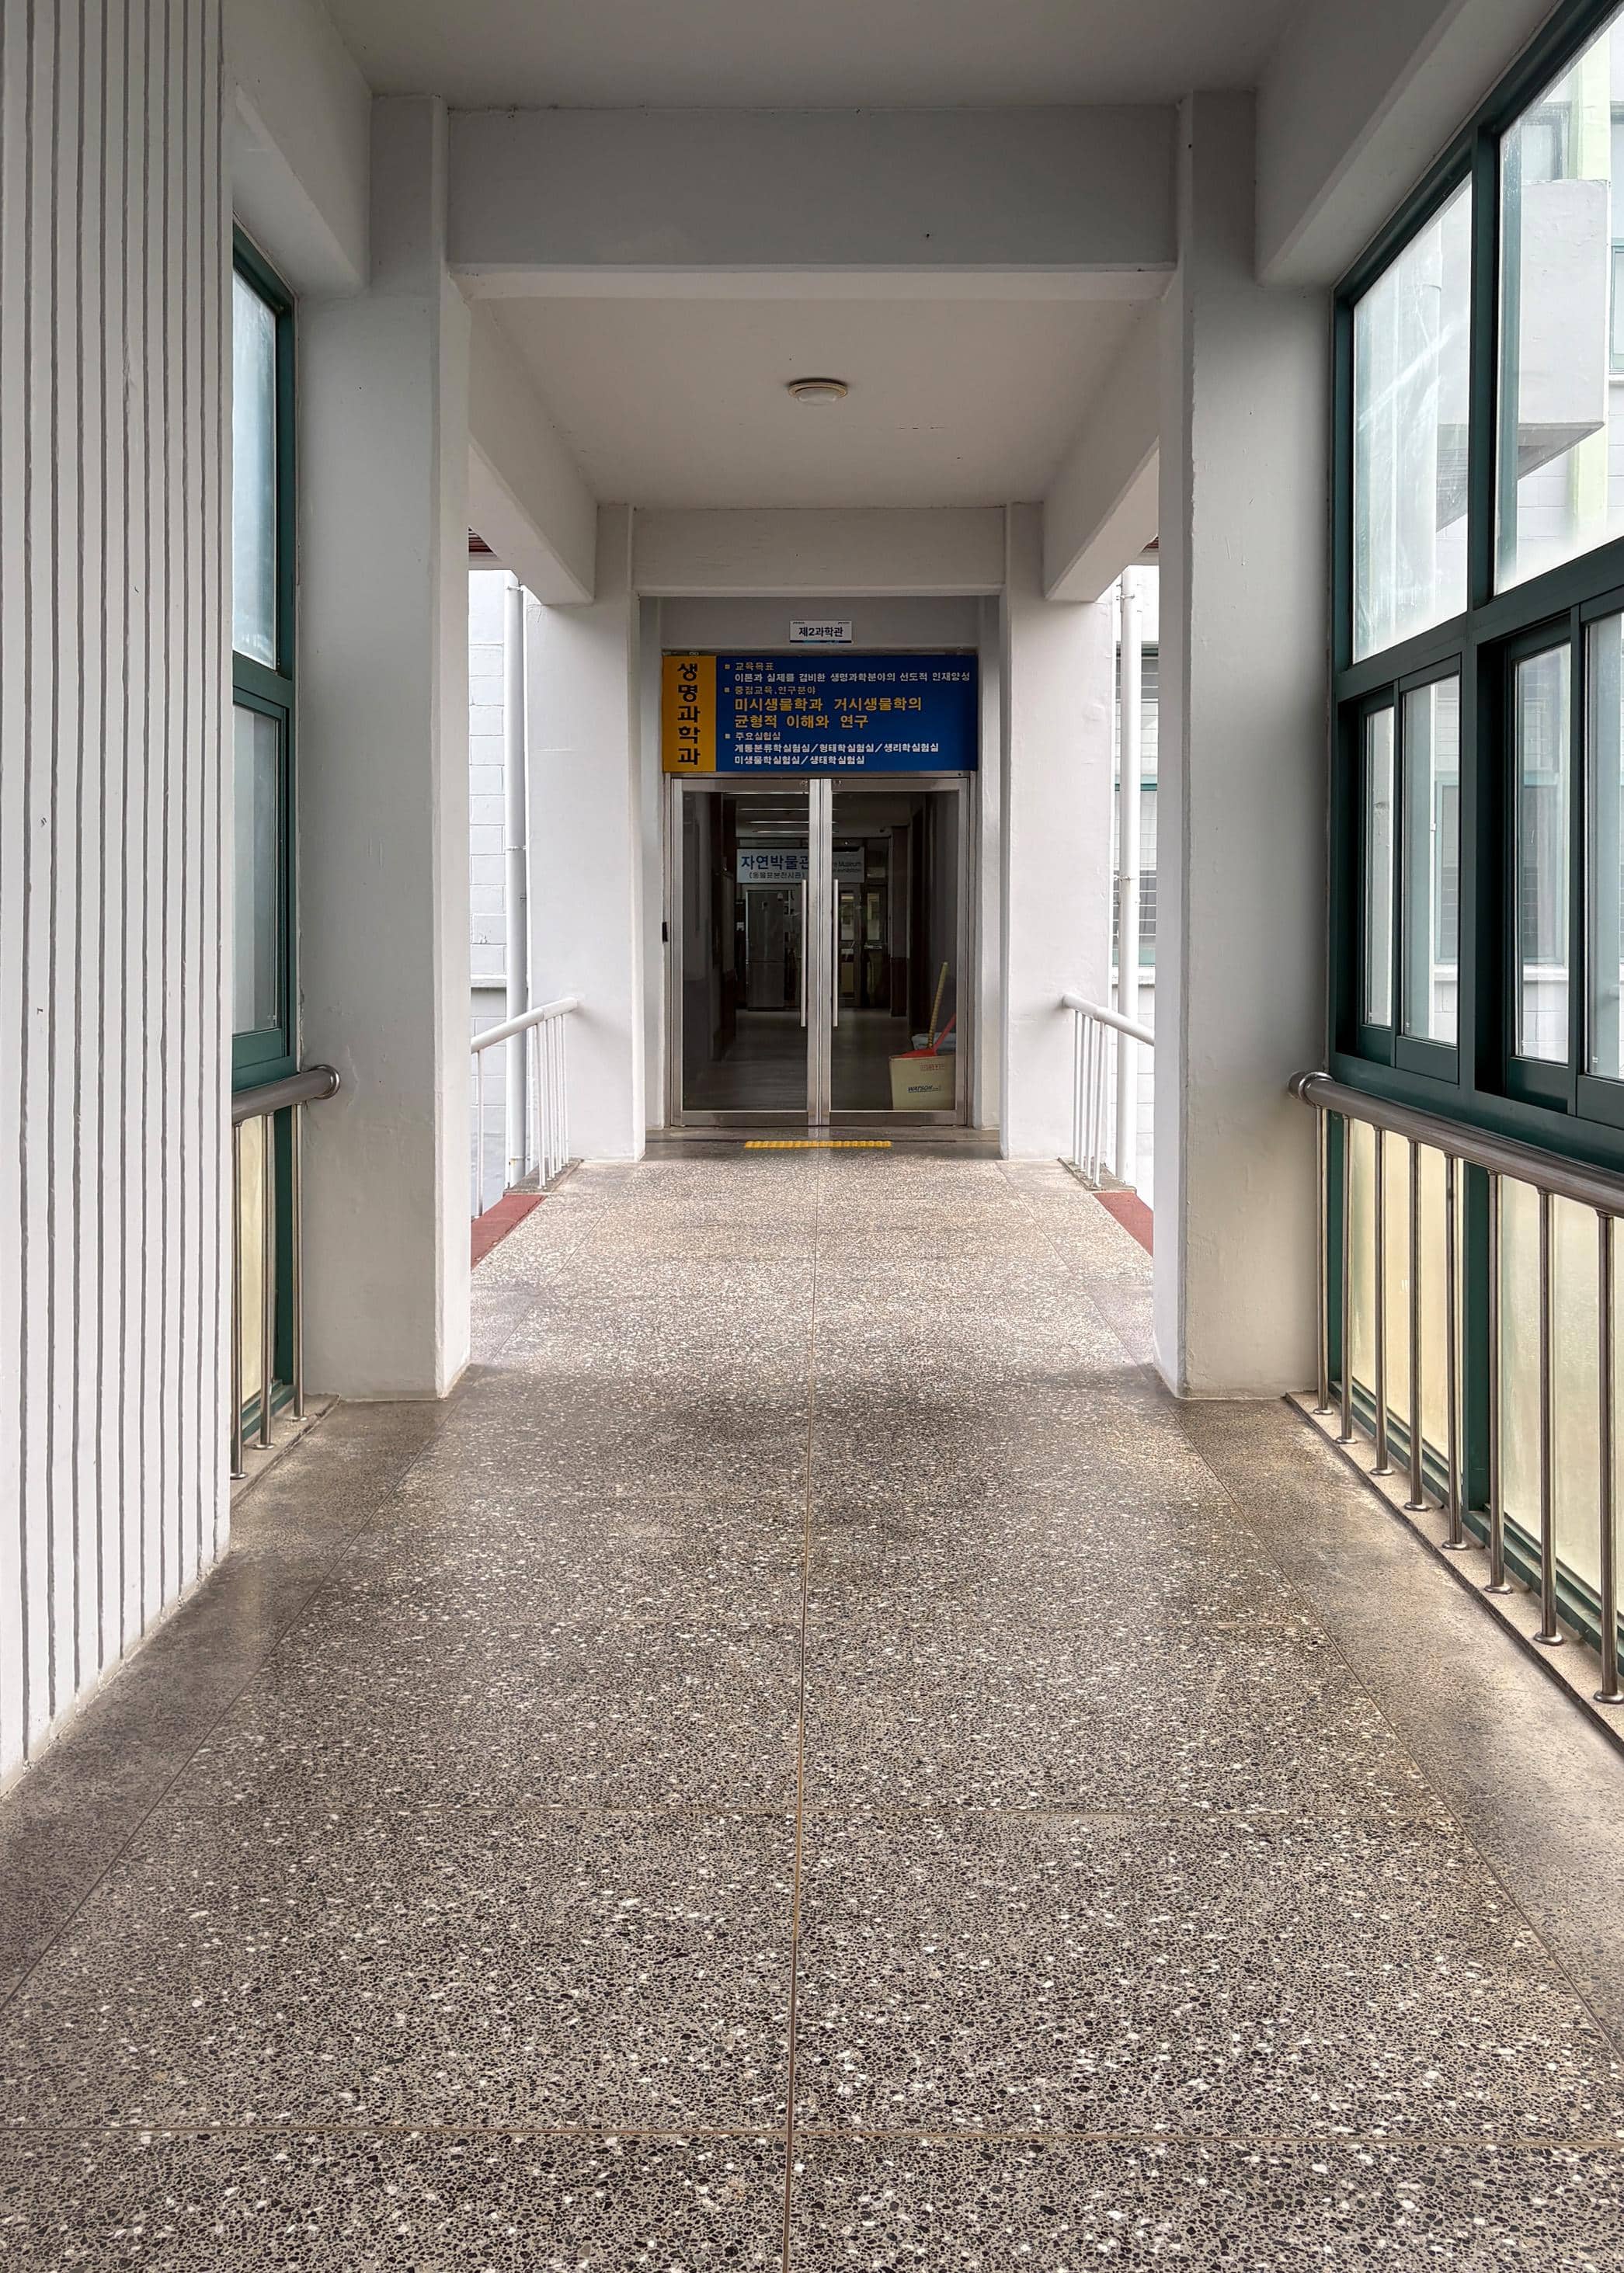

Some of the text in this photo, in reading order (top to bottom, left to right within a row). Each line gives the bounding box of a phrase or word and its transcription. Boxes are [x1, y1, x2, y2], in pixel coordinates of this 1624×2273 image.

[798, 626, 843, 638] 제2과학관
[735, 662, 775, 671] 교육목표
[830, 673, 895, 683] 생명과학분야의
[899, 673, 927, 683] 선도적
[932, 672, 970, 682] 인재양성
[735, 697, 922, 712] 미시생물학과 거시생물학의
[677, 662, 701, 766] 생명과학과
[735, 714, 868, 728] 균형적 이해와 연구
[735, 732, 781, 741] 주요실험실
